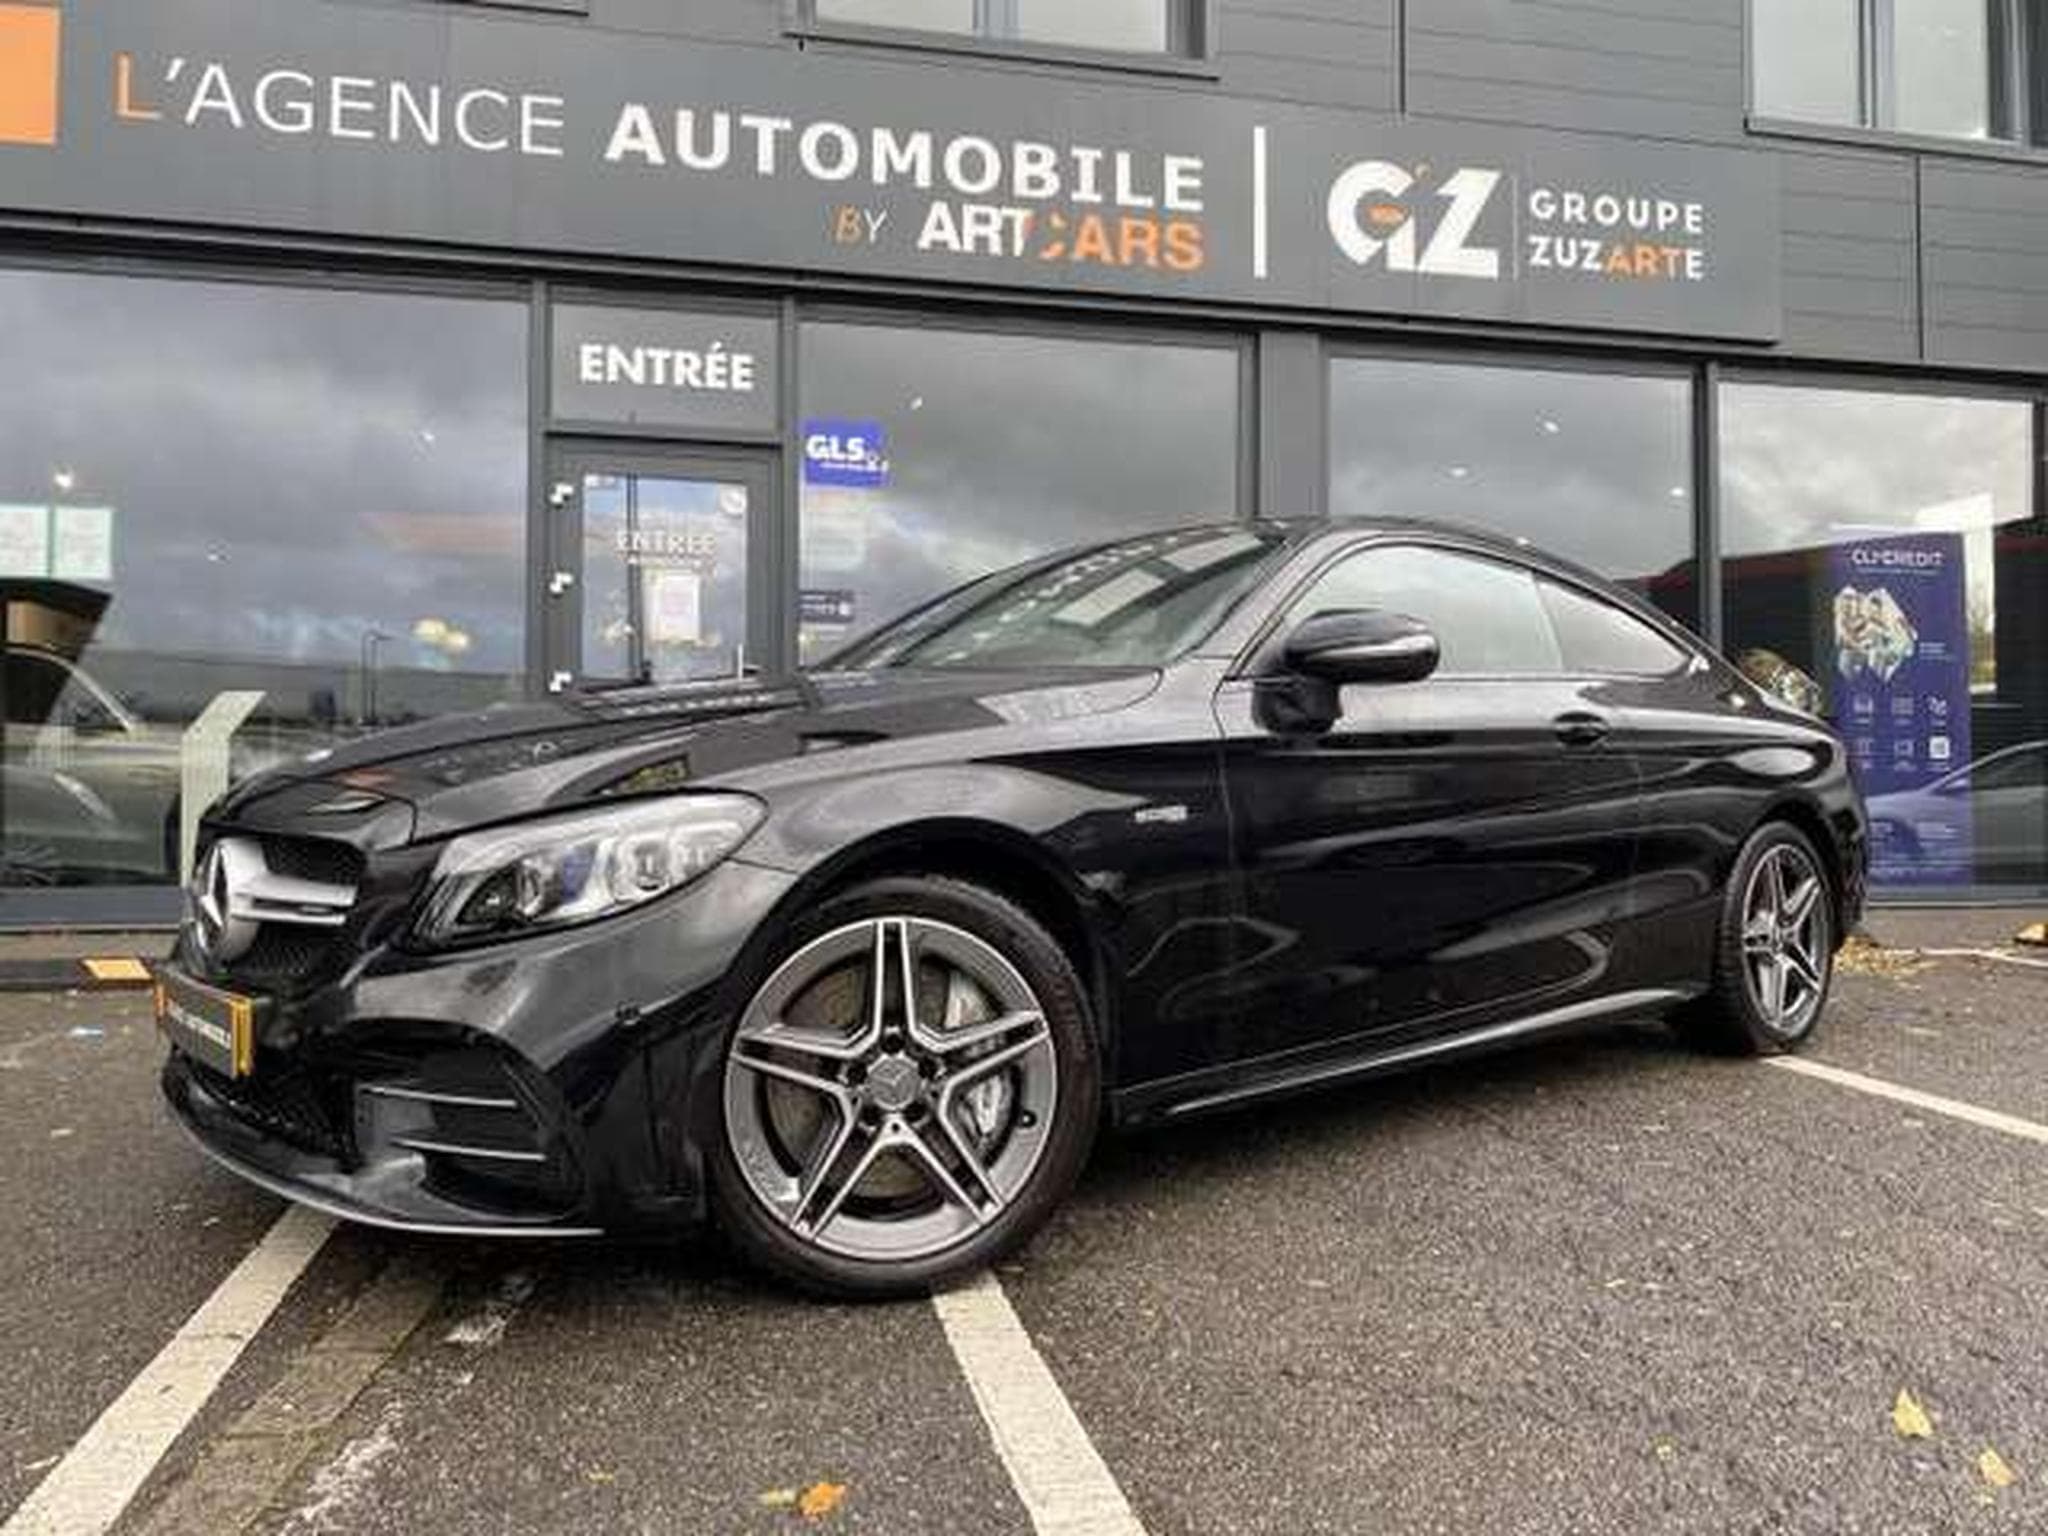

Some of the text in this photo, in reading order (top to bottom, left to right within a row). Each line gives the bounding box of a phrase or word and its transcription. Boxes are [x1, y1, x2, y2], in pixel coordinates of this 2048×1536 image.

[603, 102, 1204, 212] AUTOMOBILE
[834, 203, 888, 245] BY
[1529, 189, 1704, 234] GROUPE
[1528, 234, 1704, 281] ZUZARTE
[579, 340, 754, 390] ENTRÉE
[806, 434, 866, 461] GLS
